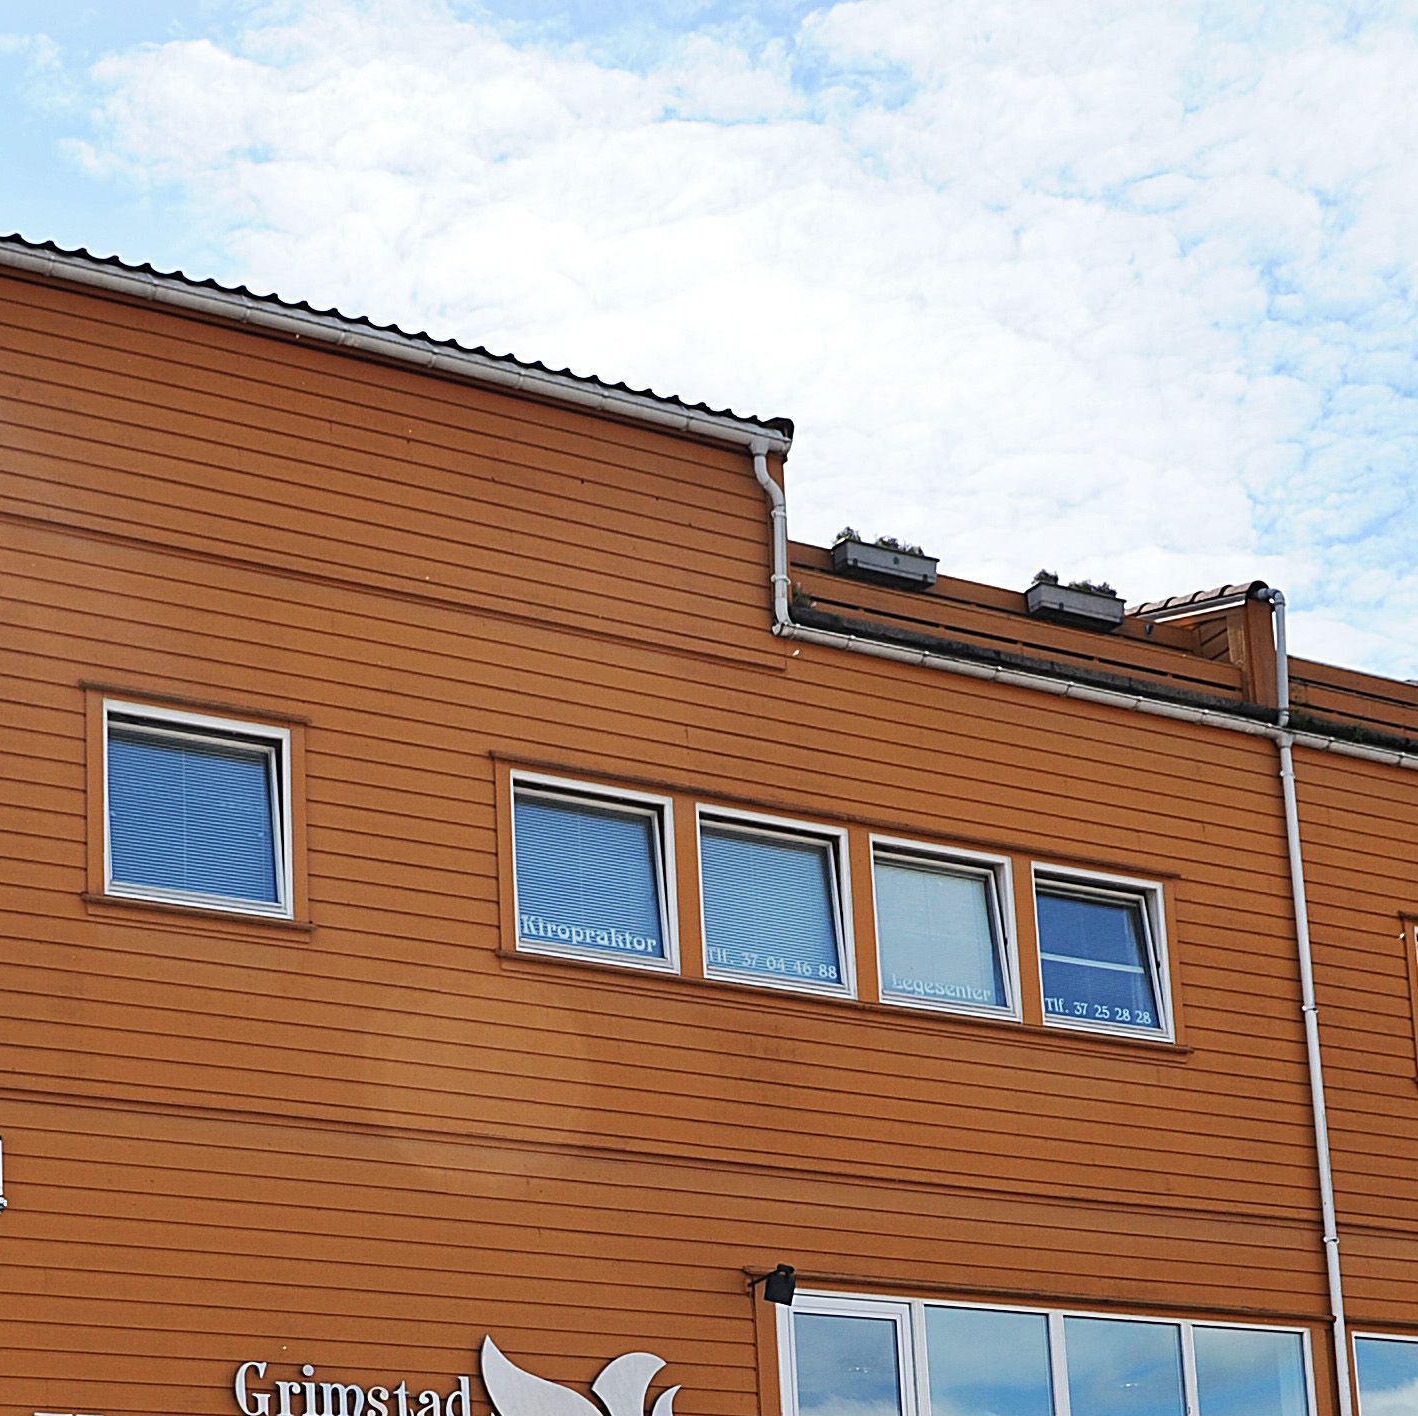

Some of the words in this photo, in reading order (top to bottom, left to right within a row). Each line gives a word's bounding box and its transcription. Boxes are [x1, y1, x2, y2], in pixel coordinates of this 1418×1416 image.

[520, 914, 657, 954] Kiropraktor
[741, 953, 758, 968] 37
[766, 955, 785, 972] 04
[793, 959, 813, 976] 46
[819, 961, 838, 979] 88
[891, 973, 992, 1002] Legesenter
[1044, 997, 1070, 1015] Tlf.
[1074, 1001, 1089, 1016] 37
[1094, 1004, 1111, 1019] 25
[1115, 1006, 1132, 1022] 28
[1135, 1009, 1152, 1025] 28
